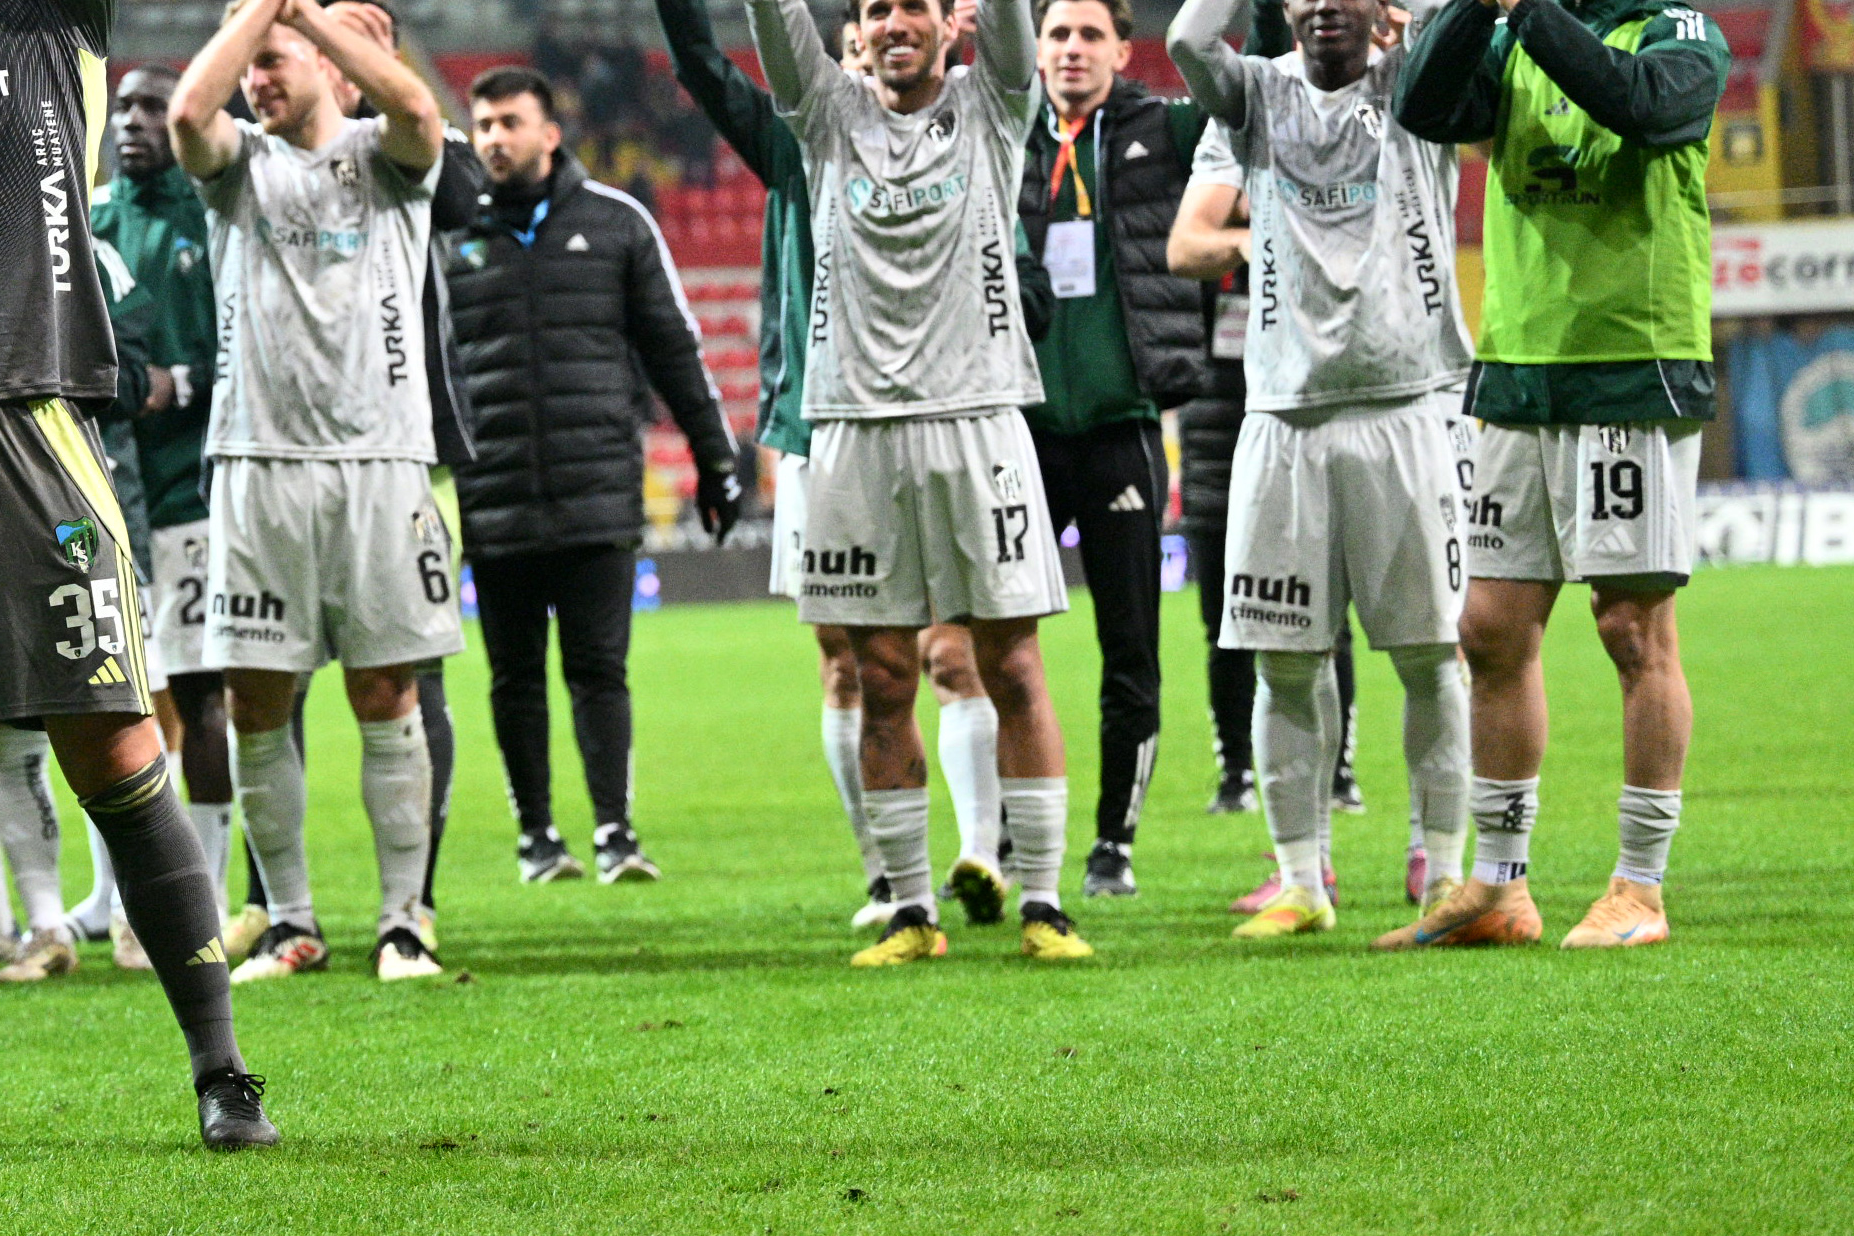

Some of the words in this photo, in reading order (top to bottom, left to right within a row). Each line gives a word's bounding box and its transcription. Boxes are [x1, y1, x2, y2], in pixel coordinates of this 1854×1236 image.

[41, 100, 64, 167] MUAYENE
[982, 241, 1010, 338] TURKA
[1262, 238, 1277, 331] TURKA
[1406, 220, 1442, 316] TURKA
[380, 293, 408, 388] TURKA
[1463, 494, 1502, 527] uh
[1591, 461, 1644, 520] 19
[992, 504, 1028, 563] 17
[177, 576, 209, 625] 2
[213, 590, 285, 621] nuh
[418, 550, 450, 604] 6
[1232, 573, 1311, 607] nuh
[48, 578, 126, 660] 35
[1231, 605, 1312, 630] çimento
